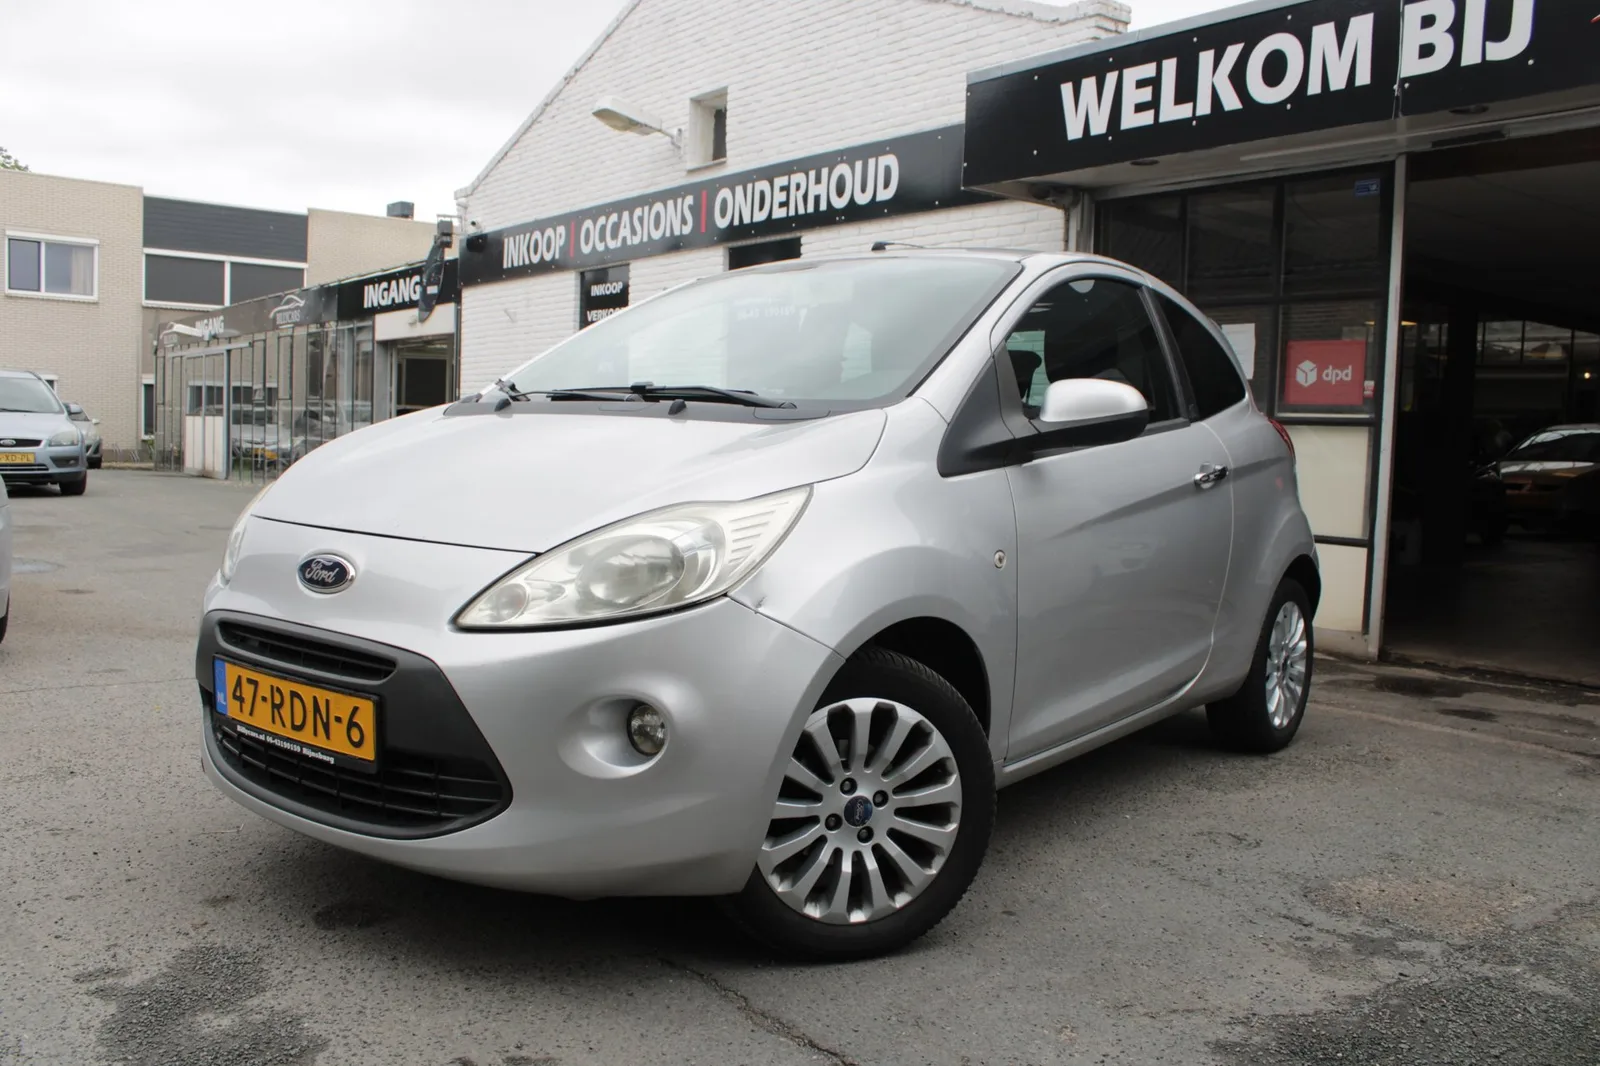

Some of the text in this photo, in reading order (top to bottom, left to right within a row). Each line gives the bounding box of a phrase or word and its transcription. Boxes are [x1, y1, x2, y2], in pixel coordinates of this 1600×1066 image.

[1060, 0, 1534, 141] WELKOM BIJ
[503, 153, 899, 269] INKOOP OCCASIONS ONDERHOUD
[363, 275, 420, 308] INGANG
[591, 282, 623, 297] INKOOP
[1322, 365, 1352, 385] dpd
[305, 558, 340, 583] Ford
[231, 674, 365, 749] 47-RDN-6
